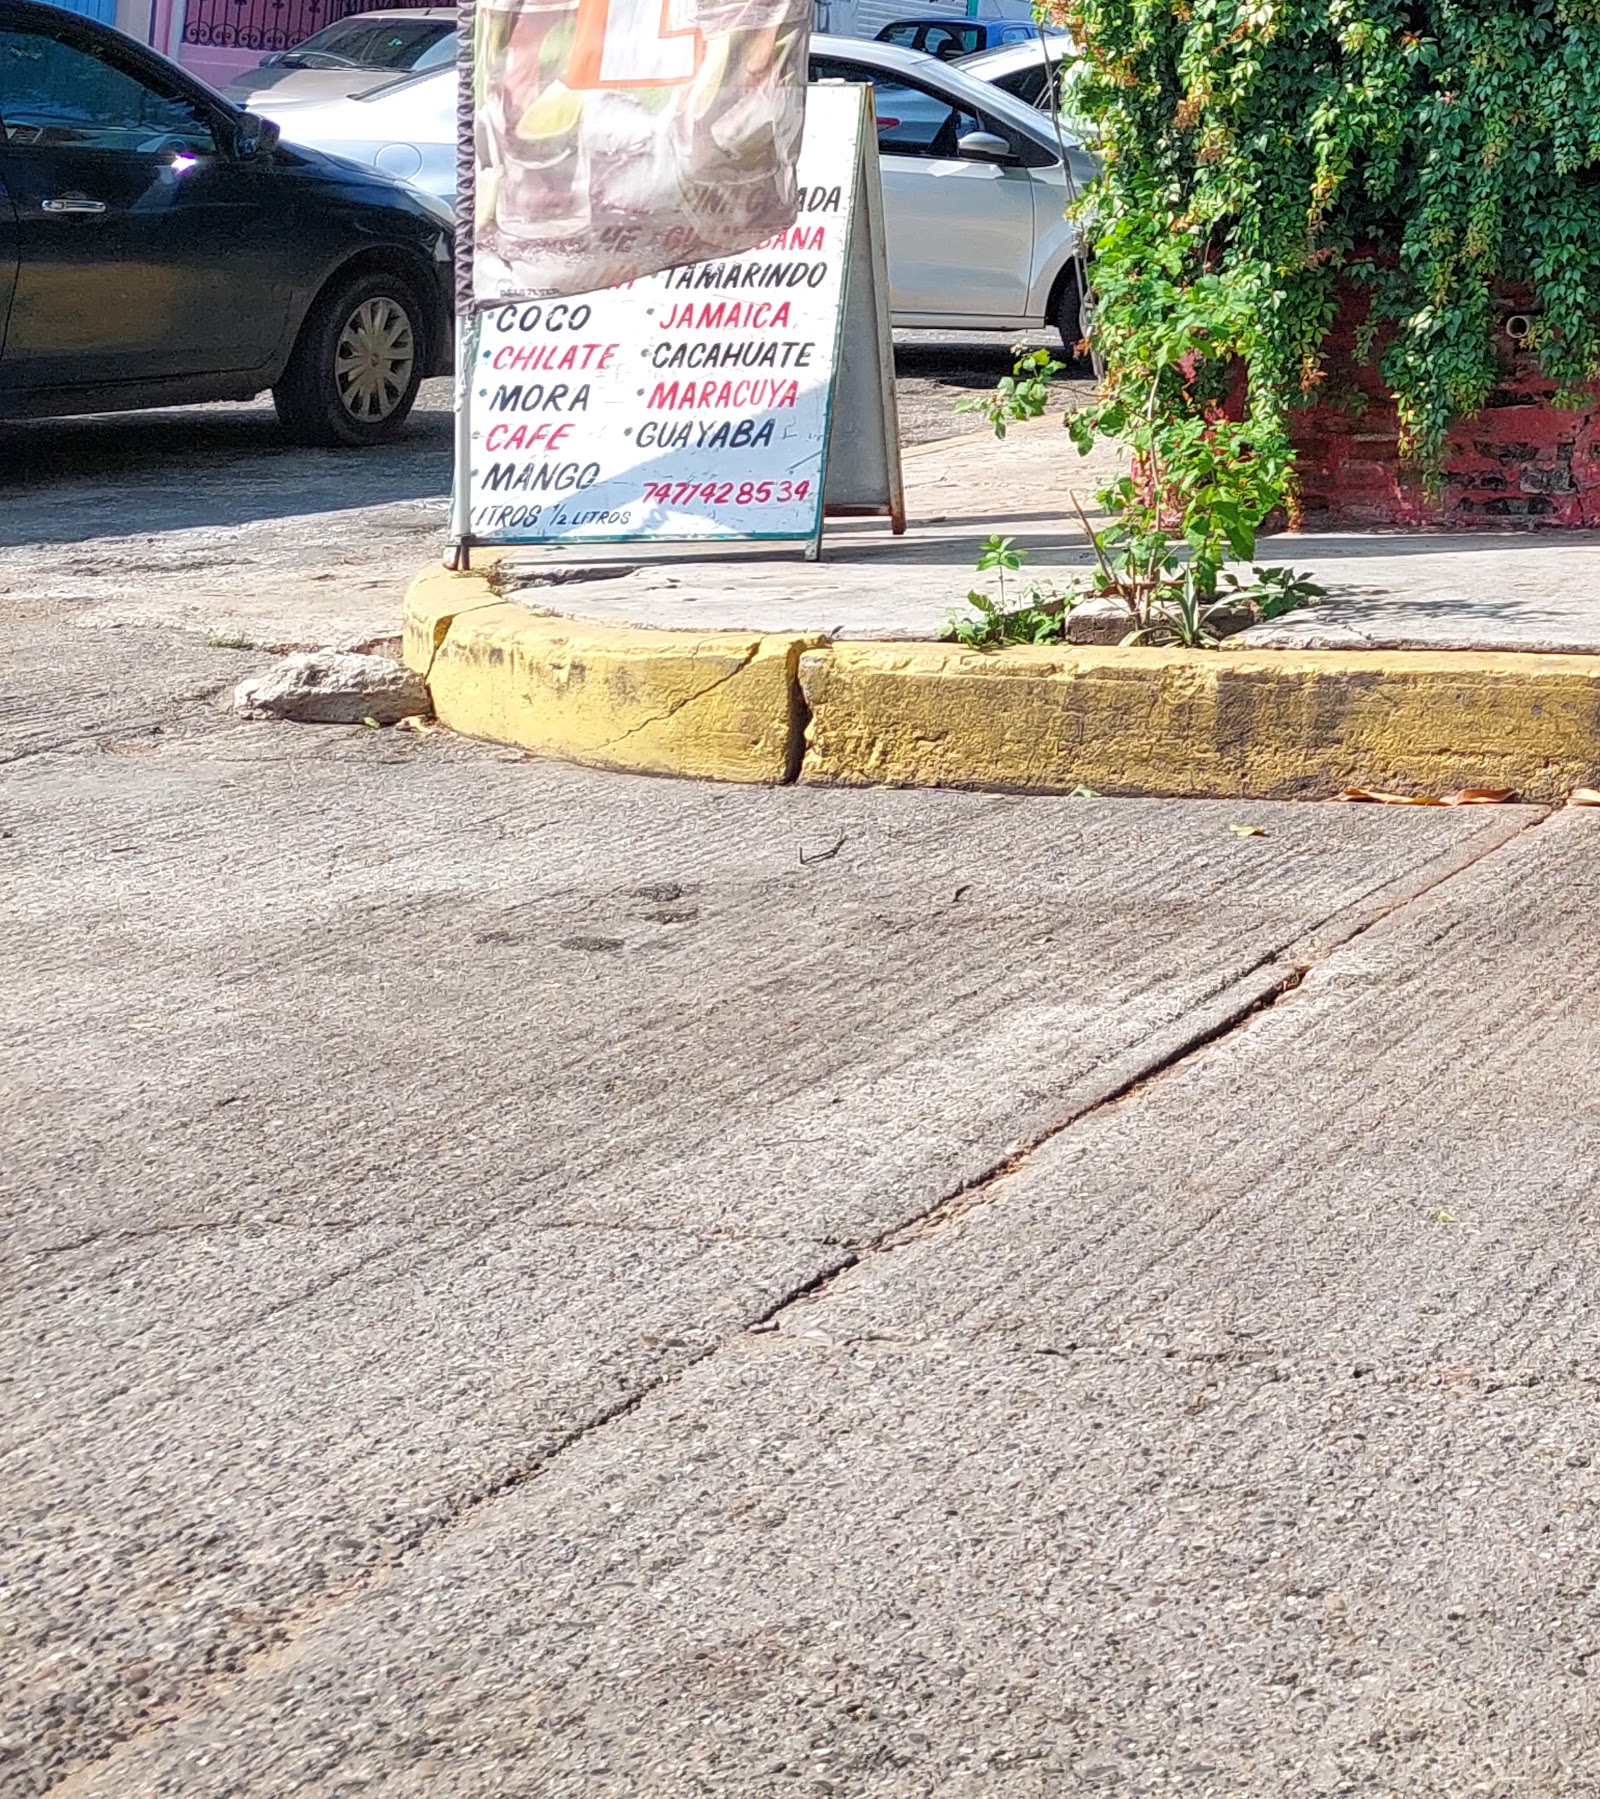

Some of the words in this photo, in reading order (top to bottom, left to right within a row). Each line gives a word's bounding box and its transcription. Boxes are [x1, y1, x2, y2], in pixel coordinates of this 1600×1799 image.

[663, 260, 828, 290] TAMARINDO
[495, 304, 592, 332] COCO
[659, 301, 792, 330] JAMAICA
[492, 343, 621, 372] CHILATE
[651, 342, 816, 369] CACAHUATE
[488, 383, 592, 413] MORA
[645, 379, 800, 410] MARACUYA
[484, 423, 576, 452] CAFE
[634, 418, 776, 449] GUAYABA
[480, 462, 601, 492] MANGO
[570, 510, 632, 526] LITROS
